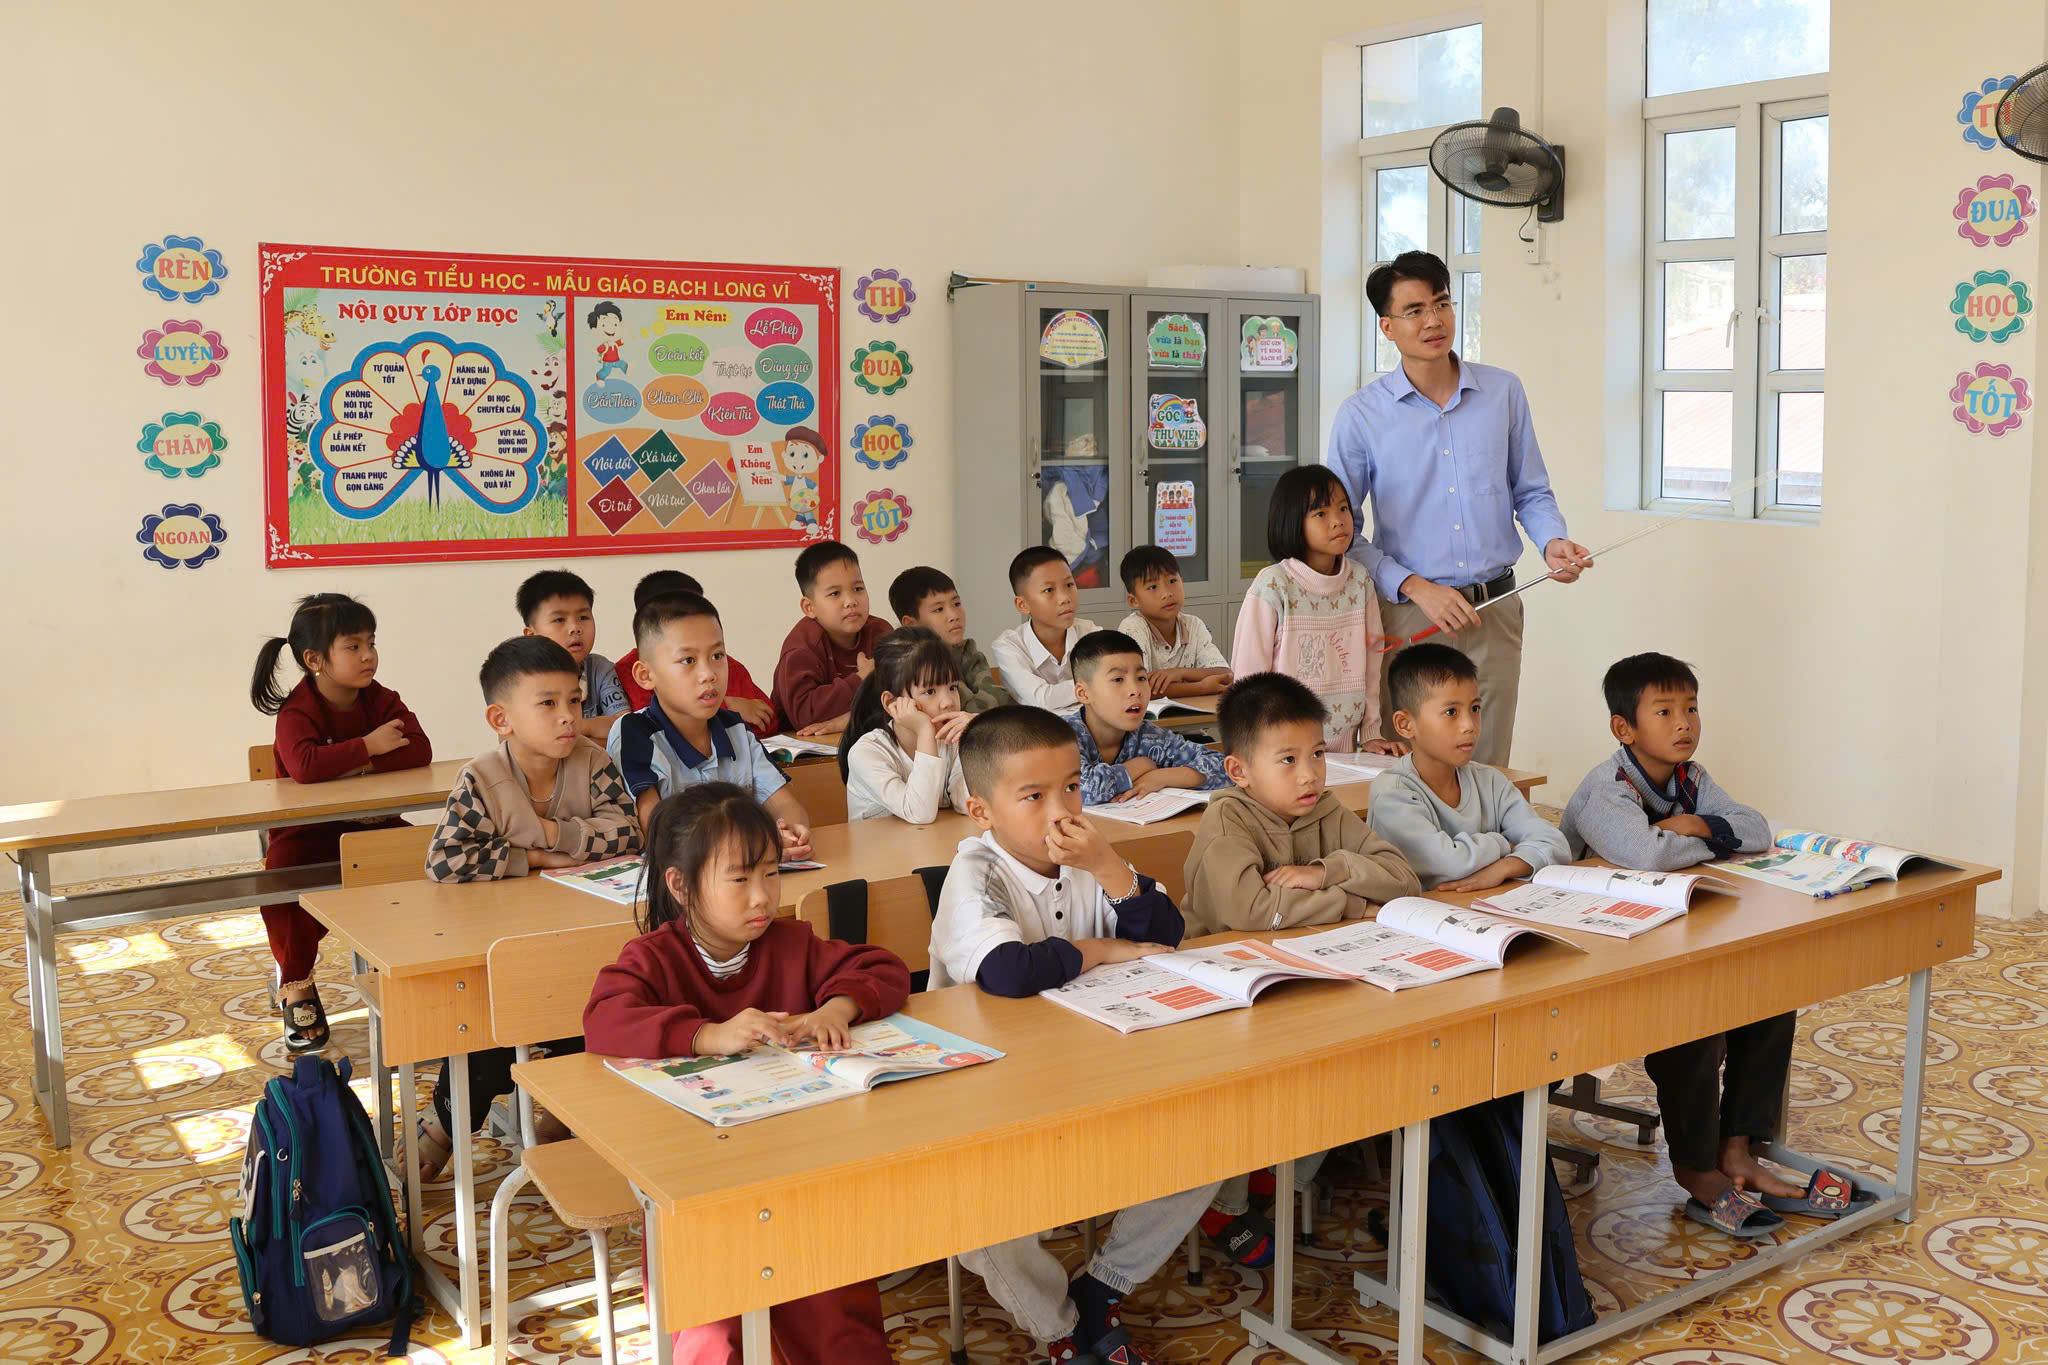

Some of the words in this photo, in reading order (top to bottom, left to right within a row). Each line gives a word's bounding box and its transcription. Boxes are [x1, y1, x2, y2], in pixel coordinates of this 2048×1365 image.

[1970, 198, 2021, 223] ĐUA
[158, 252, 210, 281] RÈN
[320, 264, 417, 287] TRƯỜNG
[424, 263, 473, 288] TIỂU
[481, 273, 526, 292] HỌC
[546, 269, 591, 292] MẪU
[598, 274, 647, 294] GIÁO
[653, 279, 707, 298] BẠCH
[714, 281, 766, 298] LONG
[772, 281, 790, 299] VĨ
[865, 286, 905, 308] THI
[338, 300, 377, 323] NỘI
[383, 304, 428, 324] QUY
[433, 303, 472, 322] LỚP
[476, 308, 518, 326] HỌC
[1967, 294, 2016, 323] HỌC
[666, 309, 690, 322] Em
[694, 310, 727, 322] Nên:
[750, 319, 768, 336] Lễ
[769, 319, 799, 340] Phép
[1168, 322, 1188, 332] Sách
[1174, 336, 1182, 344] là
[1184, 337, 1200, 346] bạn
[154, 342, 213, 365] LUYỆN
[654, 344, 686, 362] Đoàn
[688, 344, 705, 360] kết
[1172, 350, 1180, 358] là
[373, 364, 383, 372] TỰ
[384, 362, 404, 372] QUẢN
[456, 365, 475, 374] HĂNG
[760, 358, 791, 379] Đúng
[794, 360, 809, 379] giờ
[863, 359, 902, 377] ĐUA
[382, 375, 395, 383] TỐT
[452, 376, 465, 384] XÂY
[467, 377, 486, 386] DỰNG
[345, 389, 370, 398] KHÔNG
[463, 388, 475, 396] BÀI
[647, 390, 680, 405] Chăm
[1965, 378, 2017, 419] TỐT
[344, 400, 356, 408] NÓI
[359, 401, 372, 410] TỤC
[496, 395, 510, 403] HỌC
[788, 395, 806, 409] Thà
[344, 410, 356, 419] NÓI
[359, 410, 373, 420] BẬY
[477, 405, 504, 413] CHUYÊN
[707, 406, 736, 422] Kiên
[1158, 408, 1180, 422] GÓC
[333, 430, 341, 440] LỄ
[344, 432, 363, 440] PHÉP
[513, 428, 526, 436] RÁC
[1154, 428, 1176, 439] THƯ
[1177, 427, 1200, 440] VIỆN
[154, 434, 214, 456] CHĂM
[330, 442, 351, 452] ĐOÀN
[352, 442, 366, 452] KẾT
[498, 437, 515, 445] ĐÚNG
[863, 434, 901, 456] HỌC
[498, 446, 510, 454] QUY
[512, 446, 527, 454] ĐỊNH
[747, 445, 762, 454] Em
[592, 456, 613, 471] Nói
[615, 455, 632, 470] dối
[640, 450, 658, 464] Xả
[660, 452, 678, 463] rác
[740, 459, 771, 469] Không
[368, 472, 388, 480] PHỤC
[480, 469, 503, 477] KHÔNG
[505, 469, 515, 477] ĂN
[752, 474, 773, 485] Nên:
[346, 483, 362, 492] GỌN
[364, 482, 384, 491] GÀNG
[484, 480, 498, 488] QUÀ
[500, 481, 512, 490] VẬT
[692, 482, 715, 495] Chen
[717, 481, 731, 494] lấn
[598, 498, 615, 513] Đi
[617, 498, 632, 512] trễ
[648, 494, 668, 507] Nói
[670, 494, 686, 508] tục
[863, 500, 902, 532] TỐT
[153, 530, 211, 546] NGOAN
